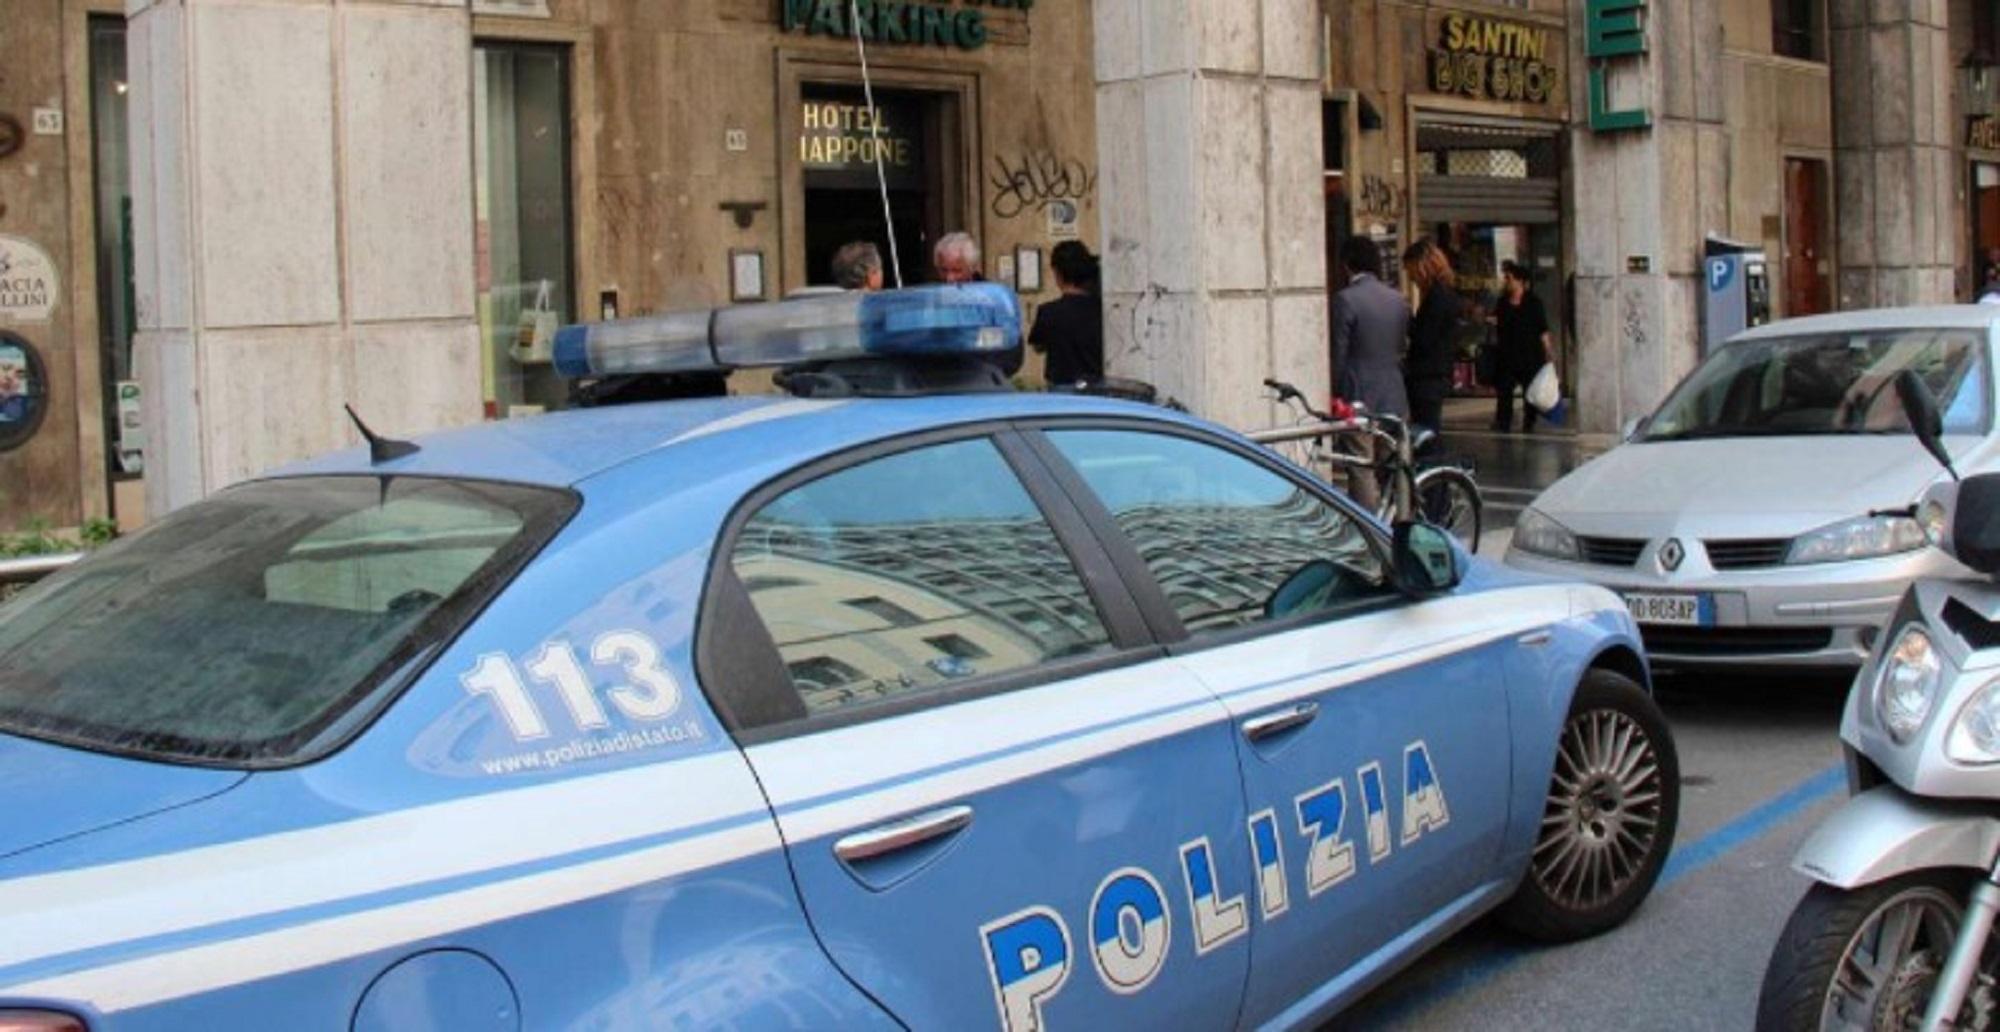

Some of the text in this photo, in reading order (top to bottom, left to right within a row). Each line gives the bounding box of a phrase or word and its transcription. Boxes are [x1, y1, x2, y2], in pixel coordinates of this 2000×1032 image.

[782, 0, 987, 48] PARKING
[1448, 15, 1546, 58] SANTINI
[803, 103, 889, 131] HOTEL
[1712, 260, 1727, 286] P
[460, 629, 681, 741] 113
[482, 719, 705, 774] www.poliziadistato.it
[979, 740, 1450, 1032] POLIZIA
